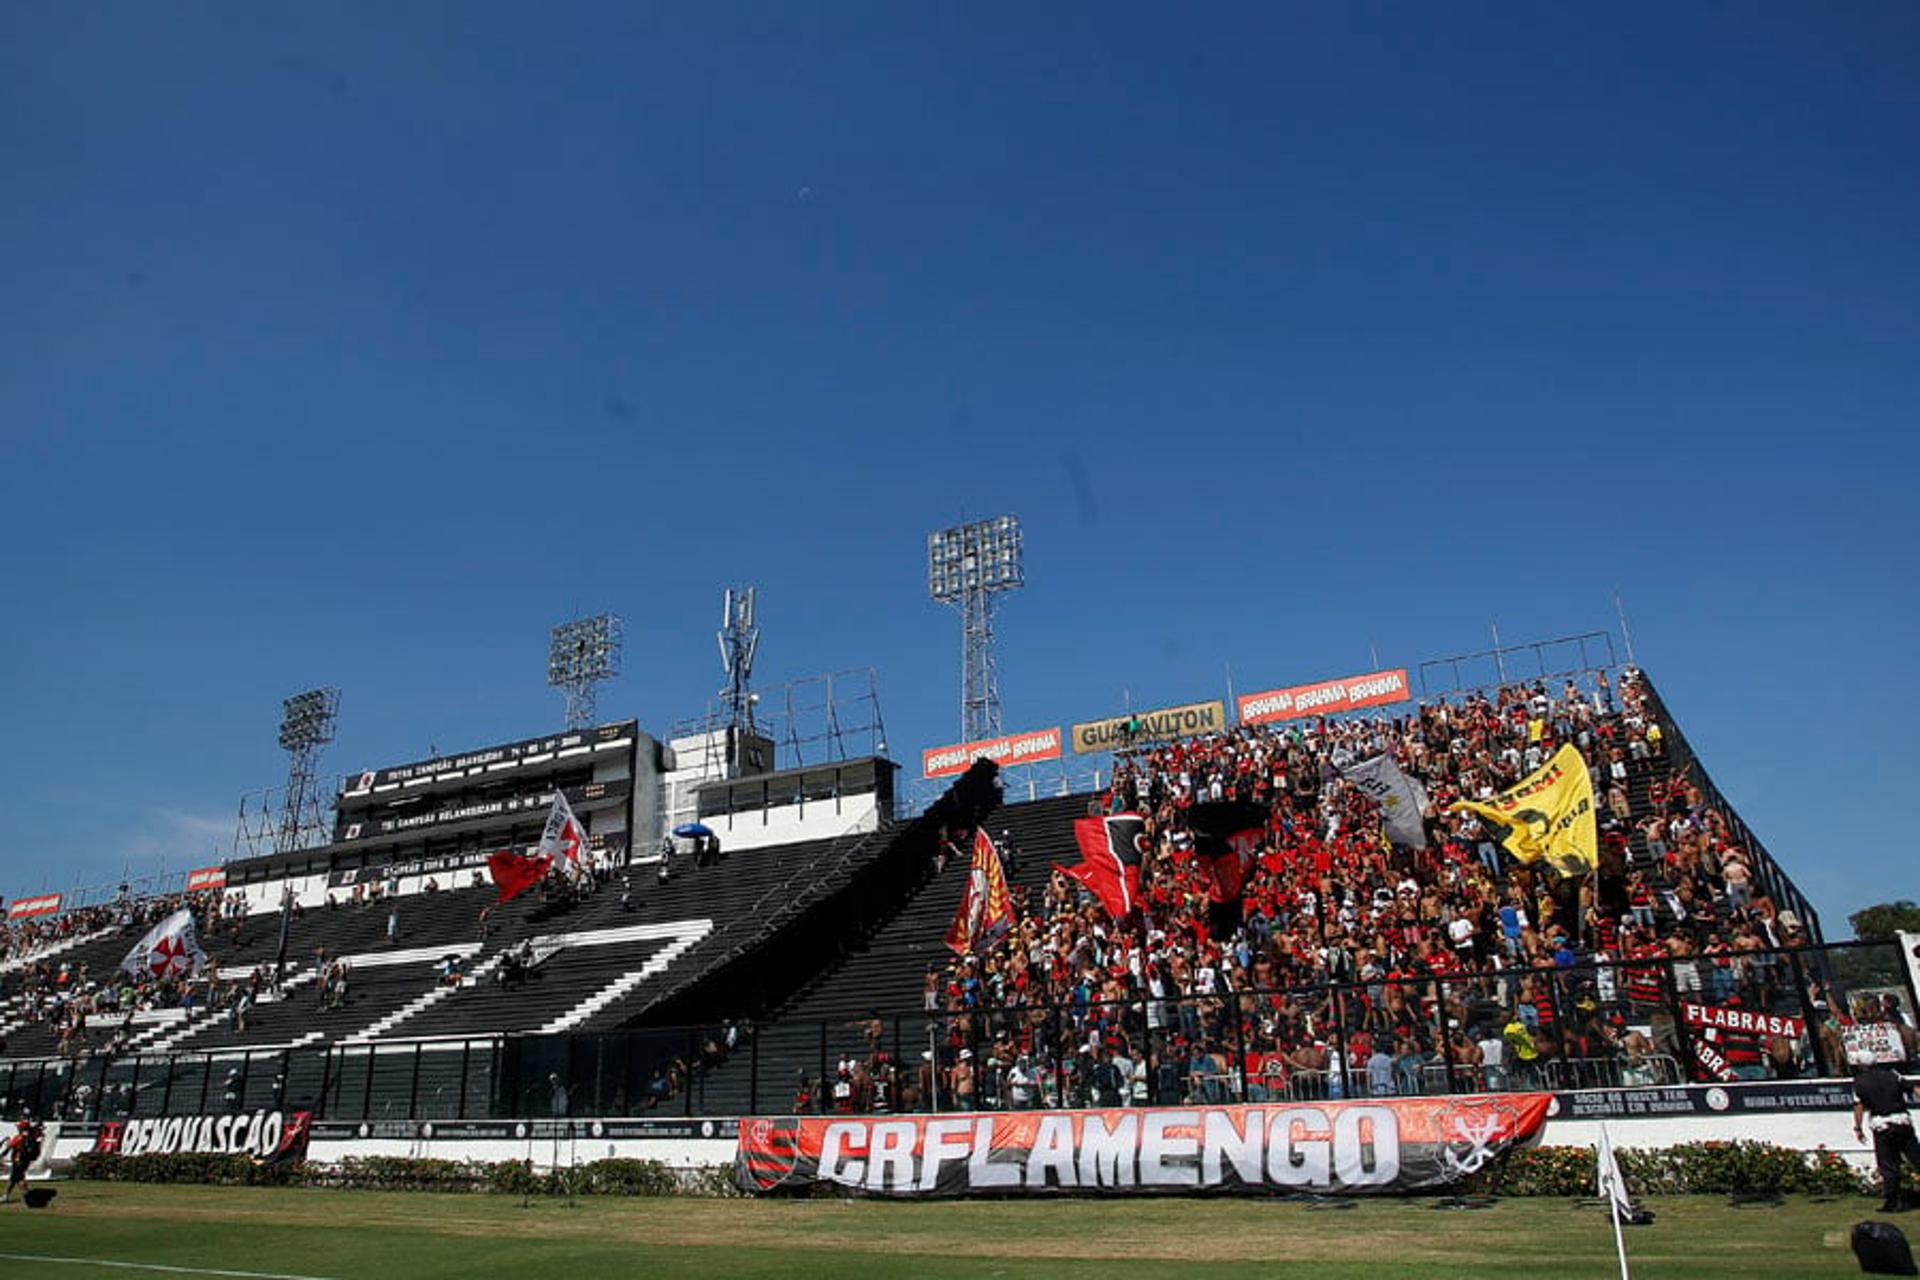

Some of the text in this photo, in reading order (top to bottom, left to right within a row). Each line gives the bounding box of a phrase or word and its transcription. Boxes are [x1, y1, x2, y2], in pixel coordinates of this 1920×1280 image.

[1243, 675, 1402, 719] BRAHMA BRAHMA BRAHMA
[1082, 708, 1214, 746] GUAAVITON
[1687, 1003, 1796, 1037] FLABRASA
[121, 1108, 284, 1156] RENOVASCÃO
